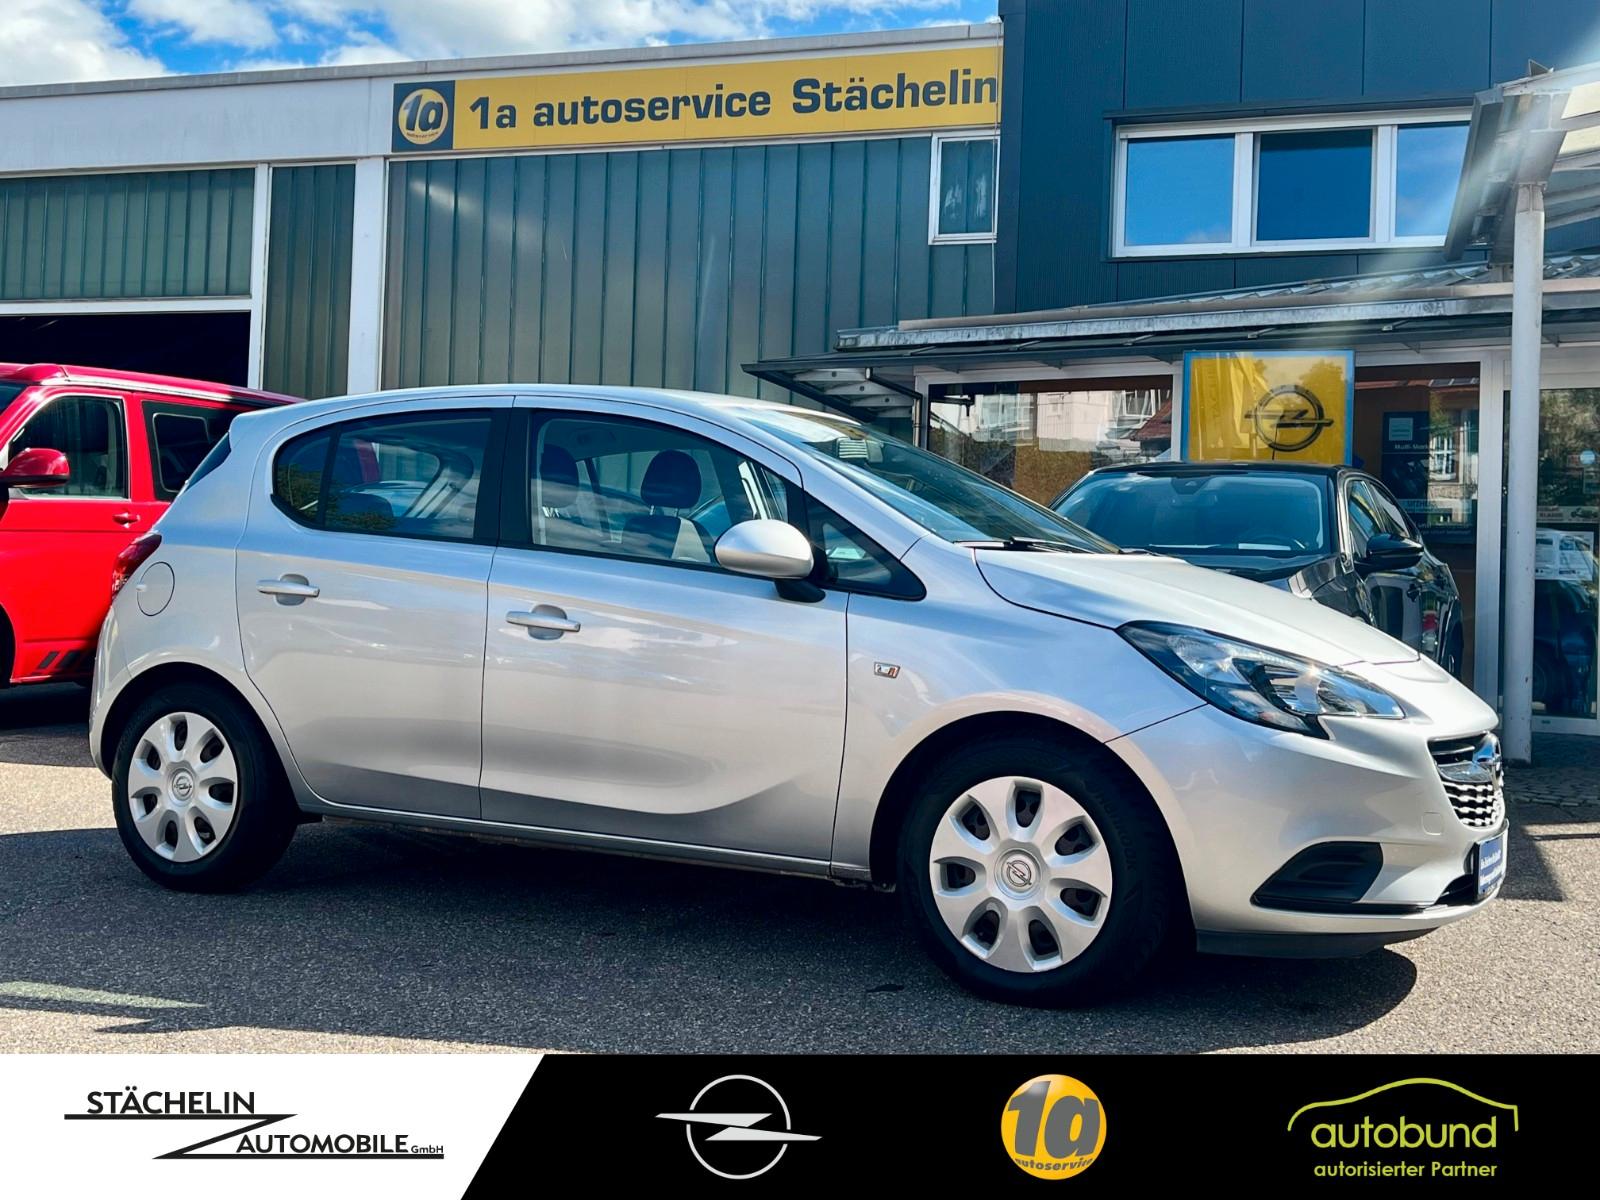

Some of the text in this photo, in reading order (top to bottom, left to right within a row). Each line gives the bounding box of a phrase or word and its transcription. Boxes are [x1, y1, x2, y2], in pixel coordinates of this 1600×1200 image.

[403, 94, 443, 131] 1a
[470, 69, 997, 129] 1a autoservice Stächelin
